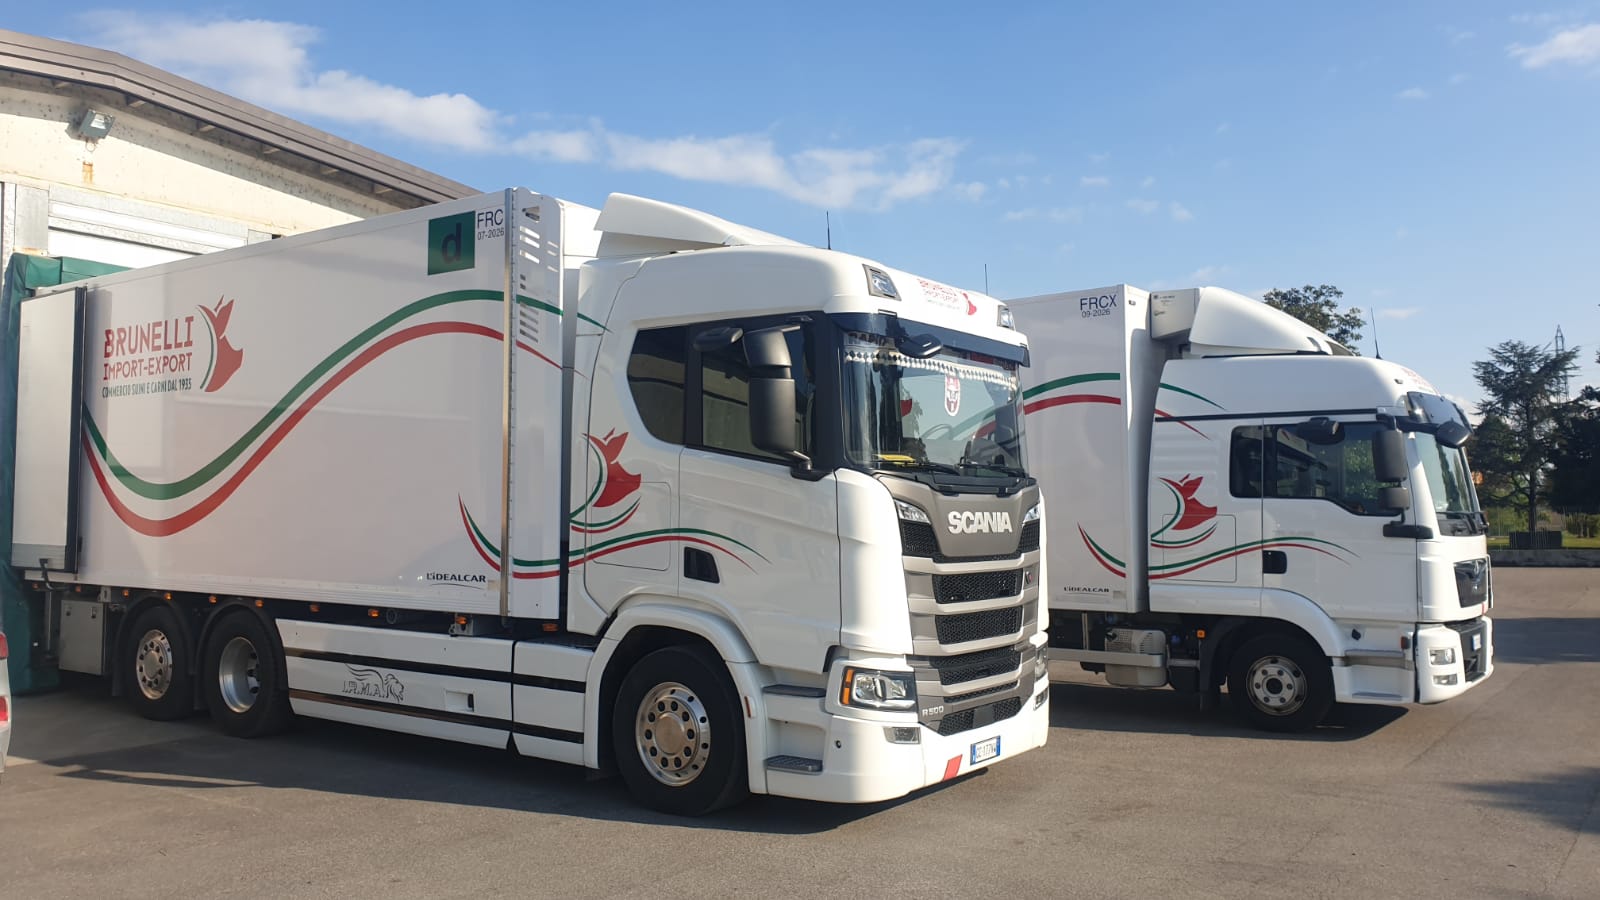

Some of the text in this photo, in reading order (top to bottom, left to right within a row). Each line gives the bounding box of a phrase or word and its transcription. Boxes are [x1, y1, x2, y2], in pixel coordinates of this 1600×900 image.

[477, 208, 504, 229] FRC
[441, 222, 462, 264] d
[477, 227, 505, 240] 07-2026
[1080, 294, 1117, 310] FRCX
[103, 315, 194, 358] BRUNELLI
[103, 352, 193, 380] IMPORT-EXPORT
[947, 510, 1013, 534] SCANIA
[928, 705, 944, 716] 500
